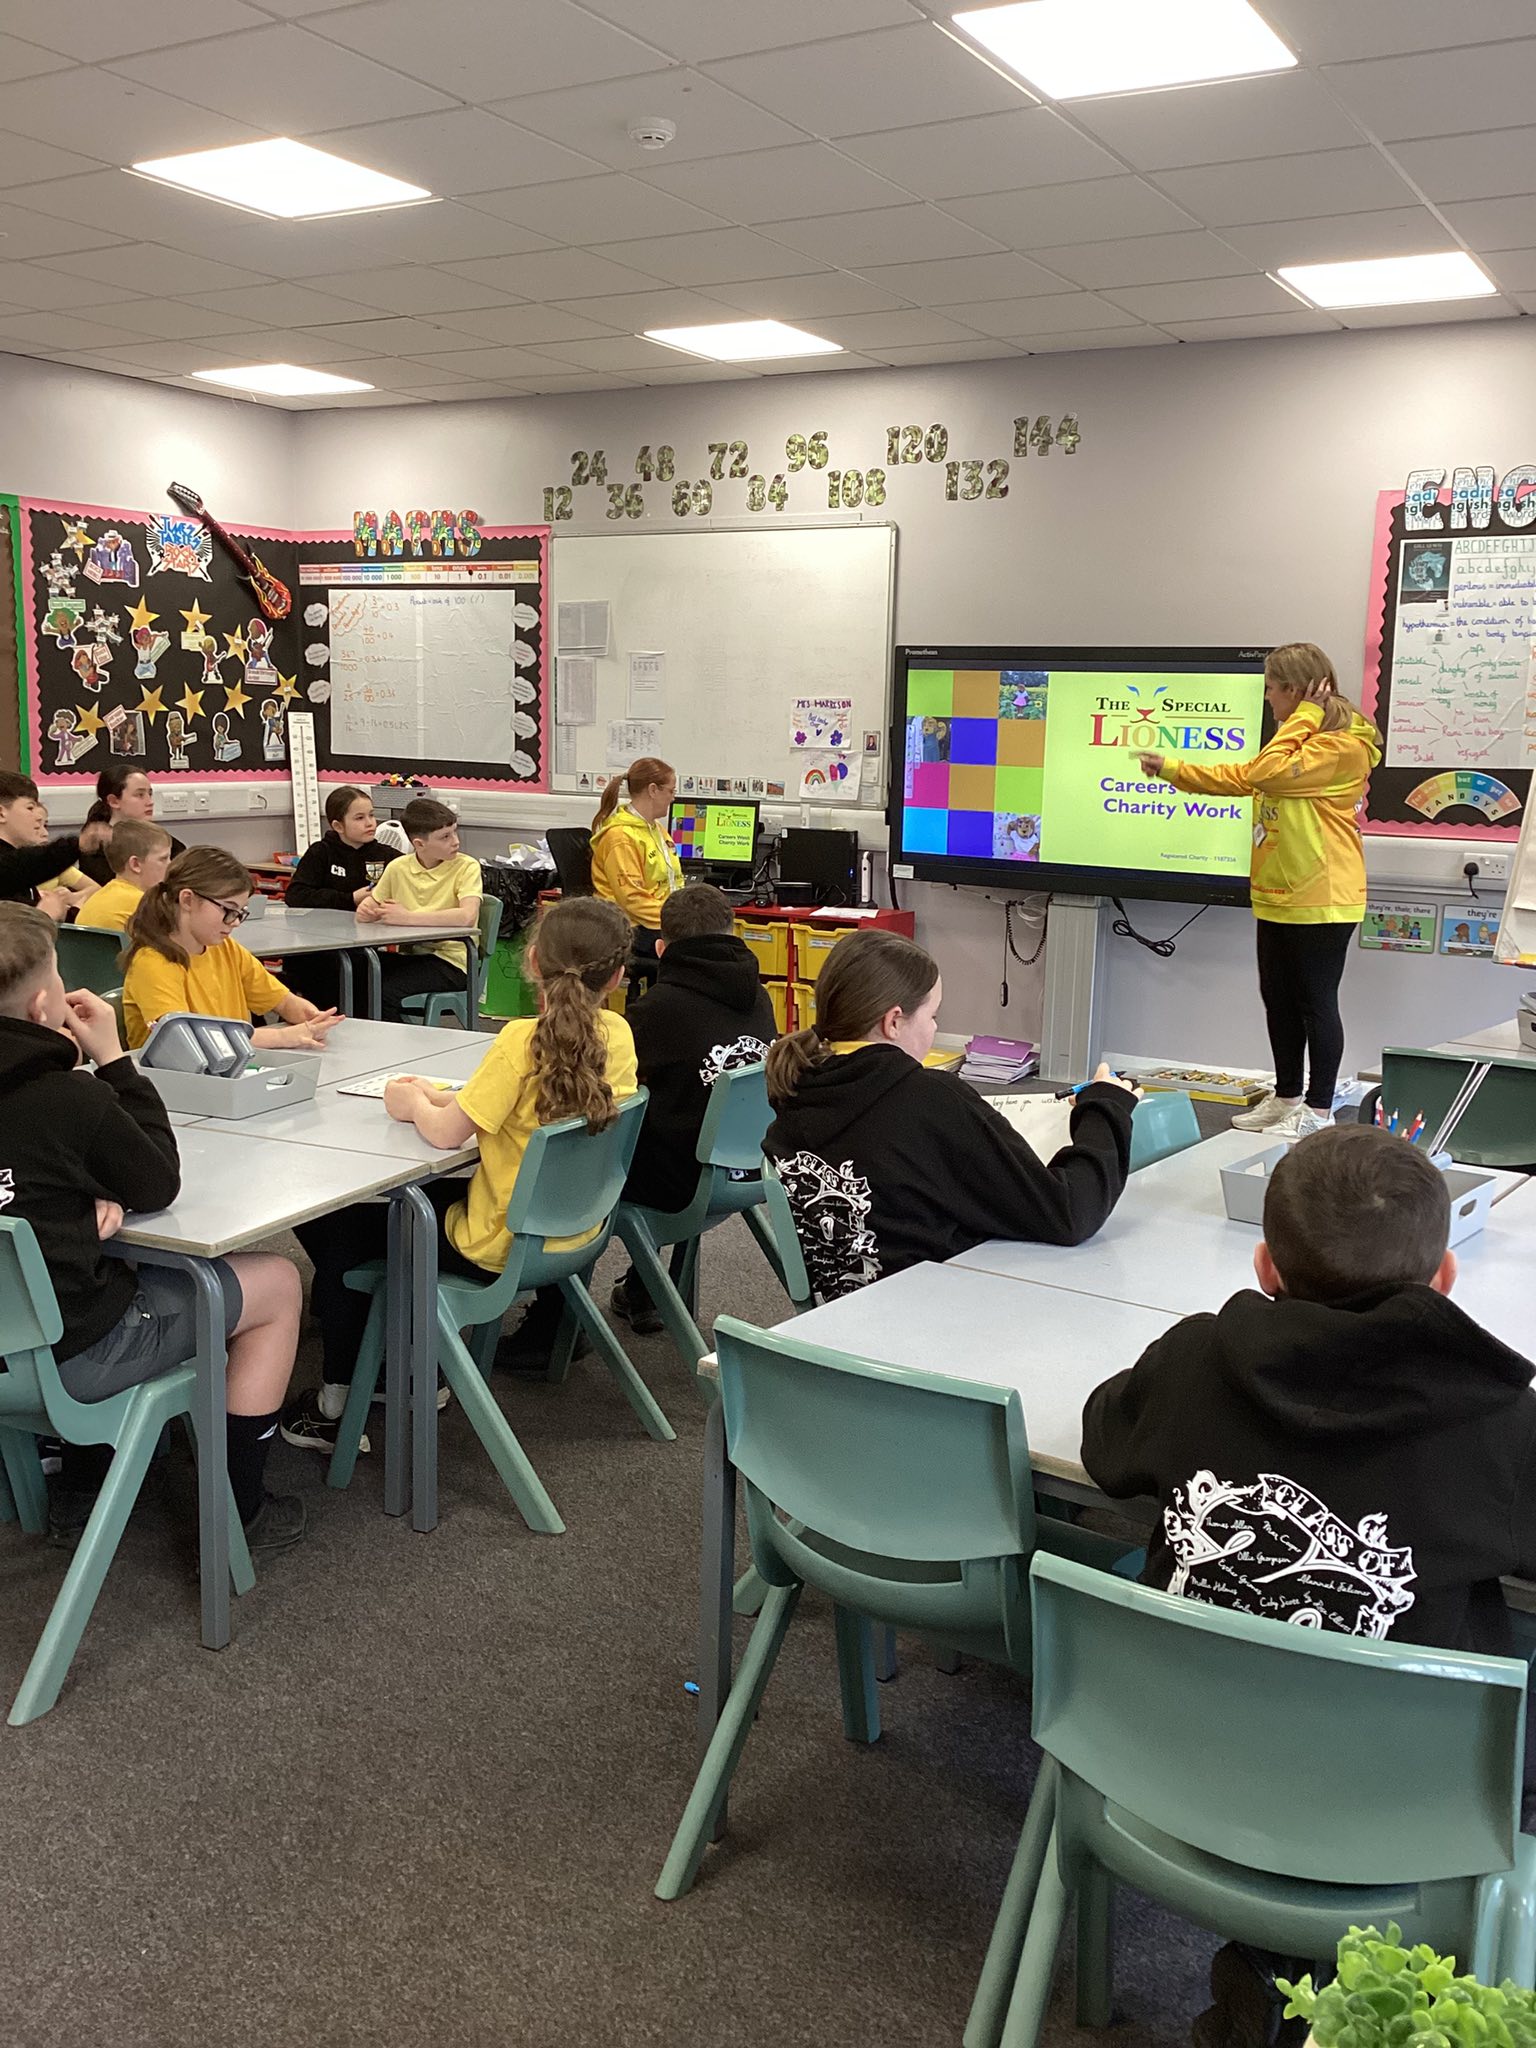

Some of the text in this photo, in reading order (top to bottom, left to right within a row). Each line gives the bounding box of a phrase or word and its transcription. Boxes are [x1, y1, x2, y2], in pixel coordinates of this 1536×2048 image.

[571, 414, 1081, 486] 24 48 72 96 120 144
[543, 459, 1009, 522] 12 36 60 84 108 132
[353, 509, 482, 557] MATHS
[1095, 697, 1231, 713] THE SPECIAL
[1088, 713, 1245, 751] LIONESS
[1100, 777, 1177, 795] Careers
[1103, 798, 1177, 820] Charity
[1183, 801, 1242, 819] Work
[330, 864, 346, 877] CR
[1467, 909, 1498, 921] they're
[802, 1154, 862, 1196] CLASS OF
[1205, 1516, 1229, 1530] Thomas
[1275, 1484, 1400, 1577] CLASS OF
[1237, 1551, 1255, 1562] Ollie
